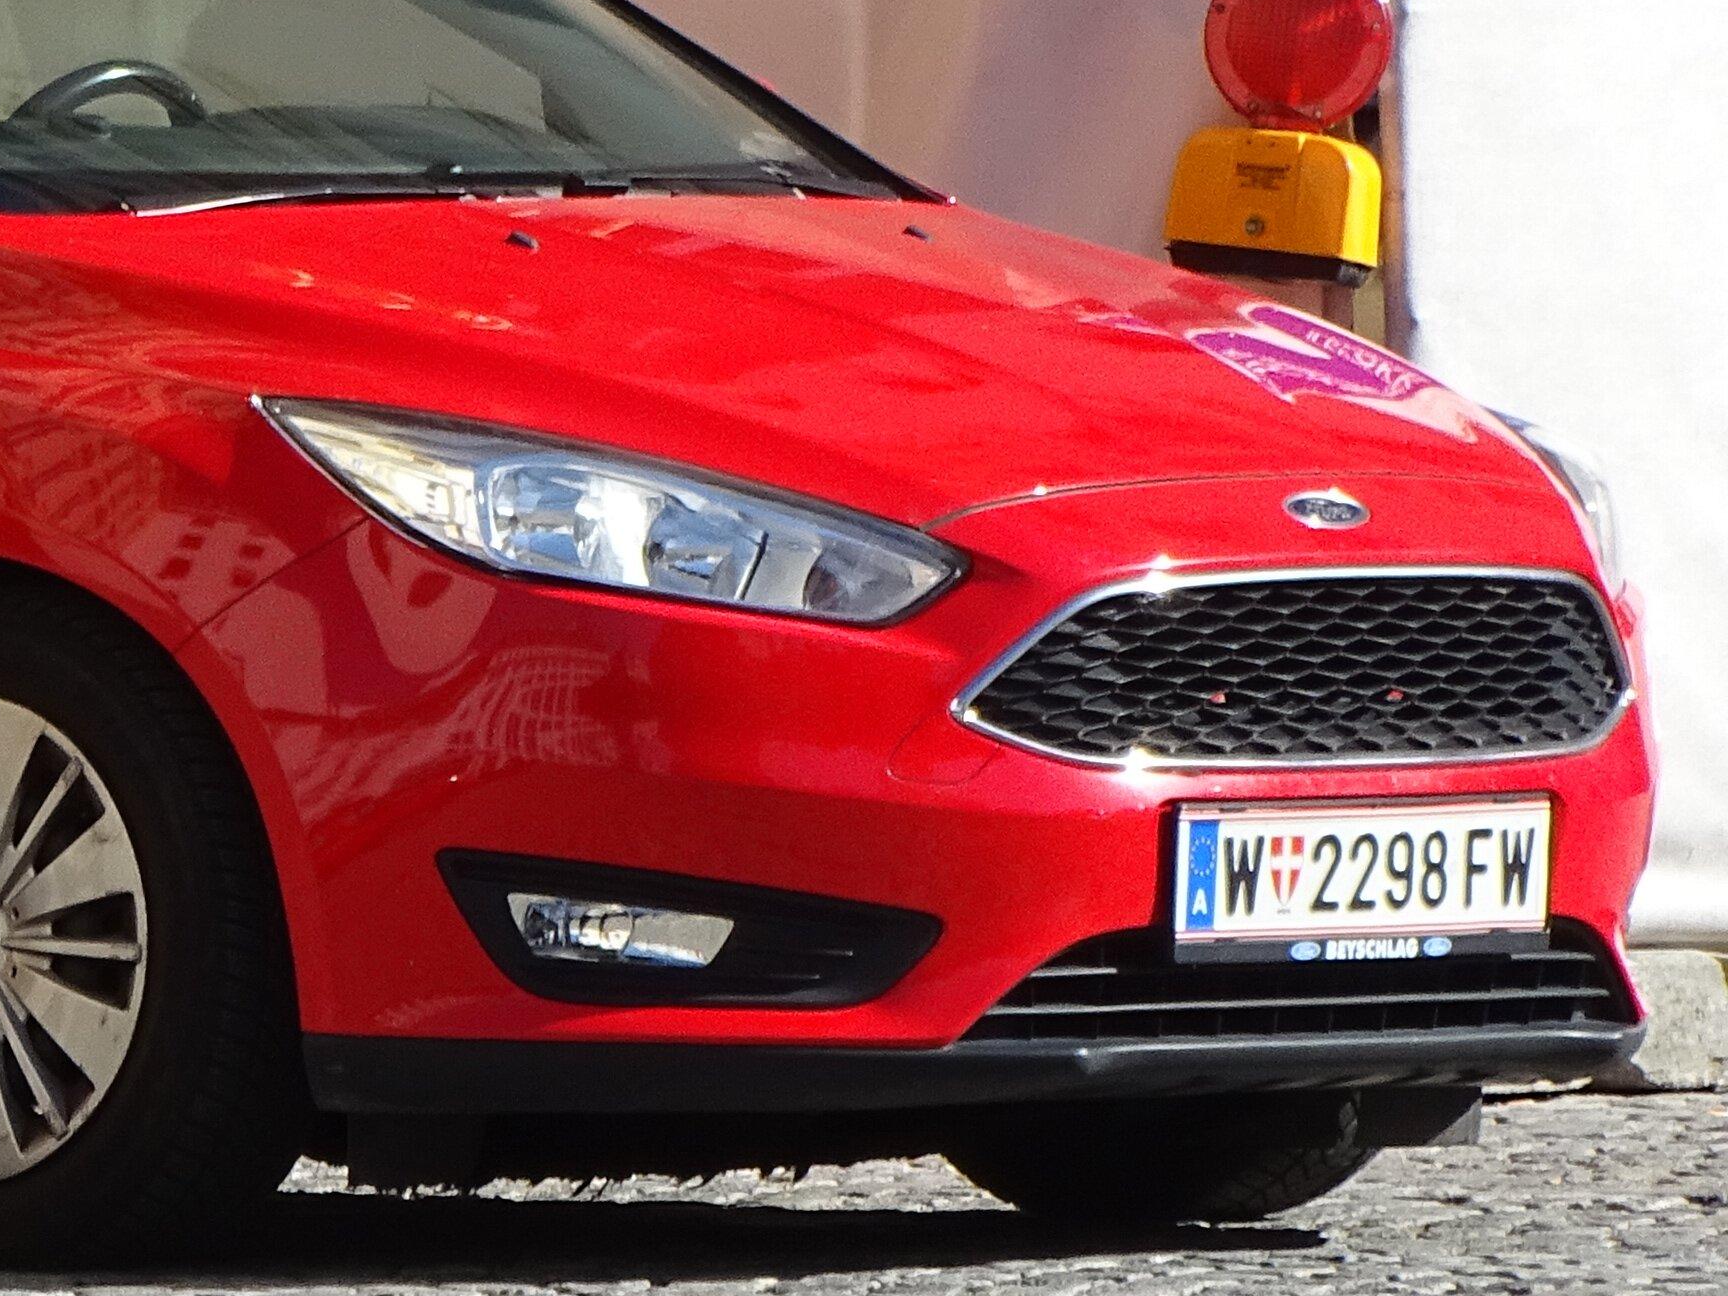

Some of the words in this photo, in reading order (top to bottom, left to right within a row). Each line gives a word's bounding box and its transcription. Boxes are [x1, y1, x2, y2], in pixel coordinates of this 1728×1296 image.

[1223, 834, 1266, 918] W
[1310, 829, 1449, 913] 2298
[1463, 825, 1537, 910] FW
[1191, 888, 1209, 917] A
[1325, 936, 1420, 961] BEYSCHLAG
